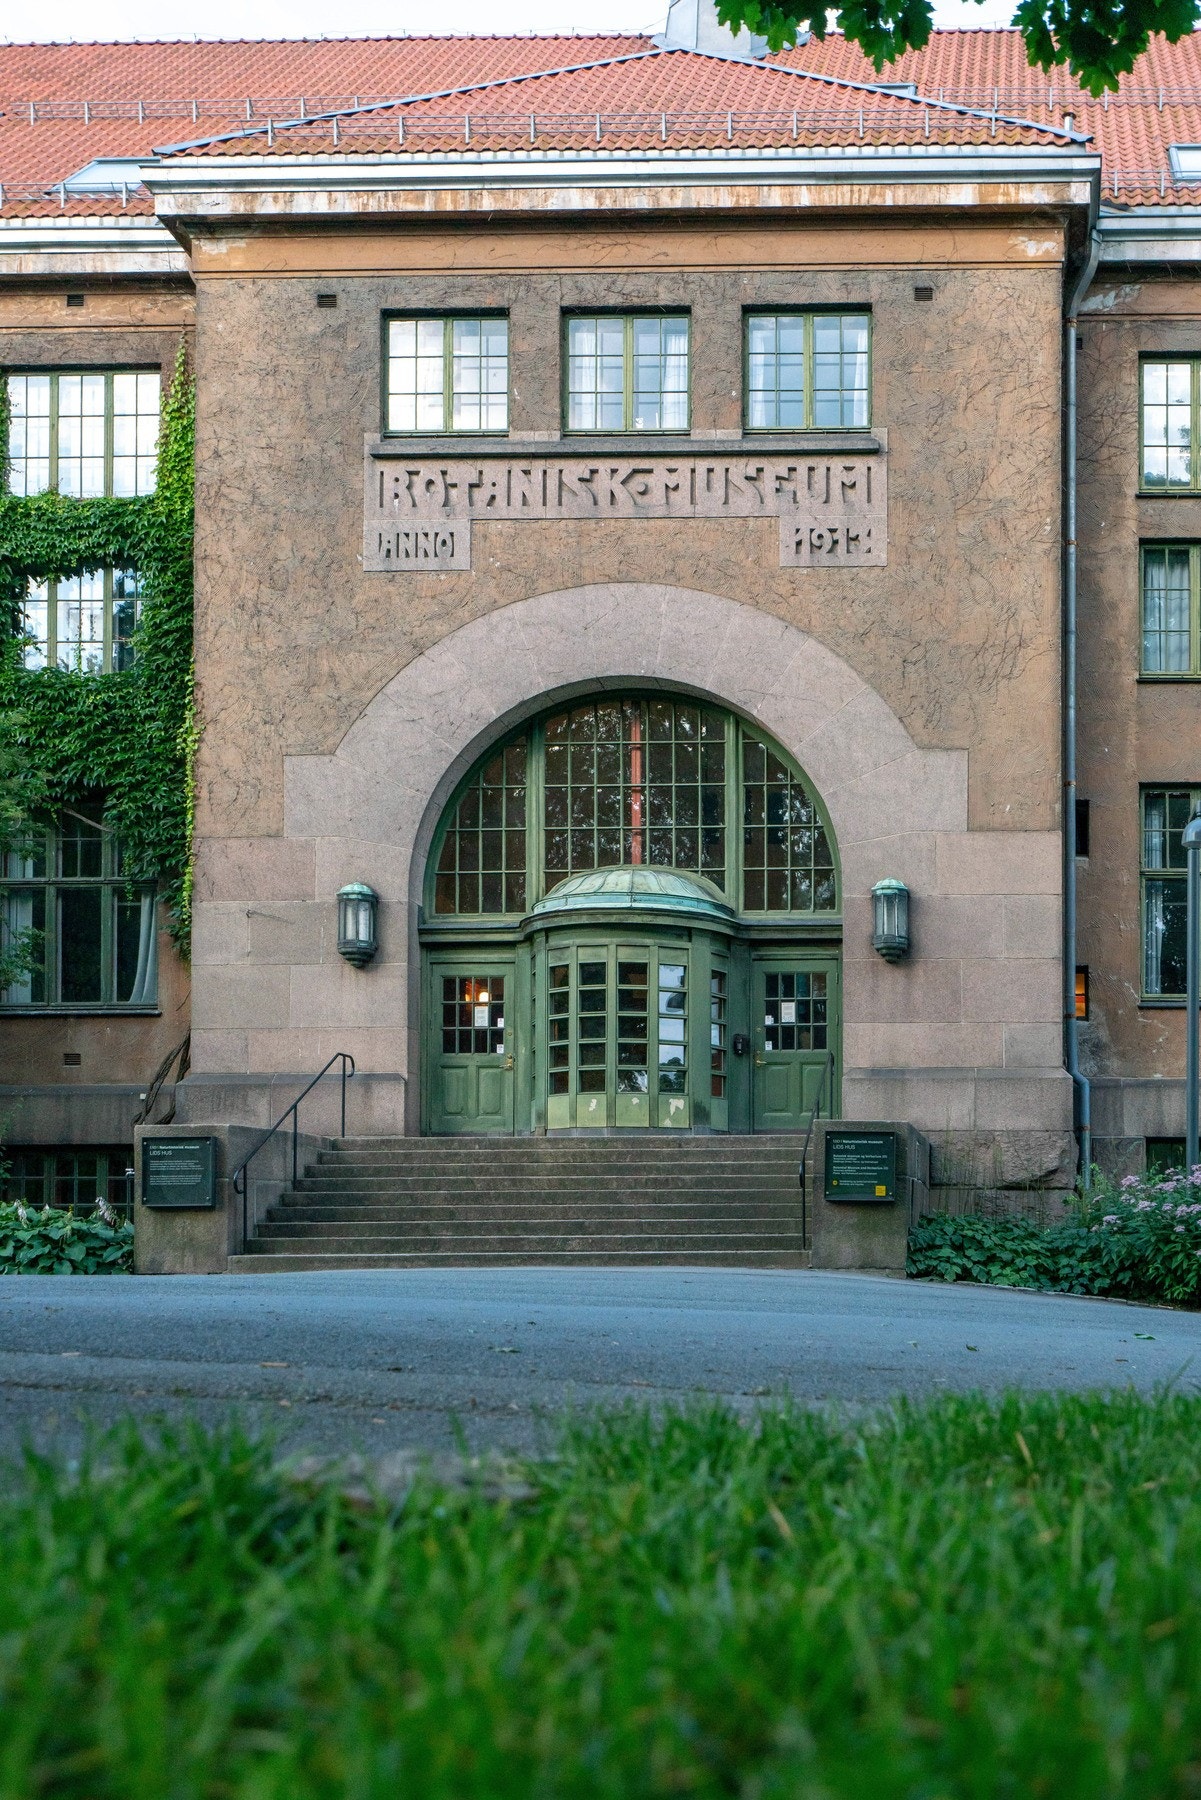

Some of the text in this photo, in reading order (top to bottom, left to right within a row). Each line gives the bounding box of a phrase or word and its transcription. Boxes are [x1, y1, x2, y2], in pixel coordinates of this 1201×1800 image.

[379, 466, 871, 508] BOTANISK MUSEUM
[378, 531, 455, 558] ANNO
[794, 527, 873, 554] 1913
